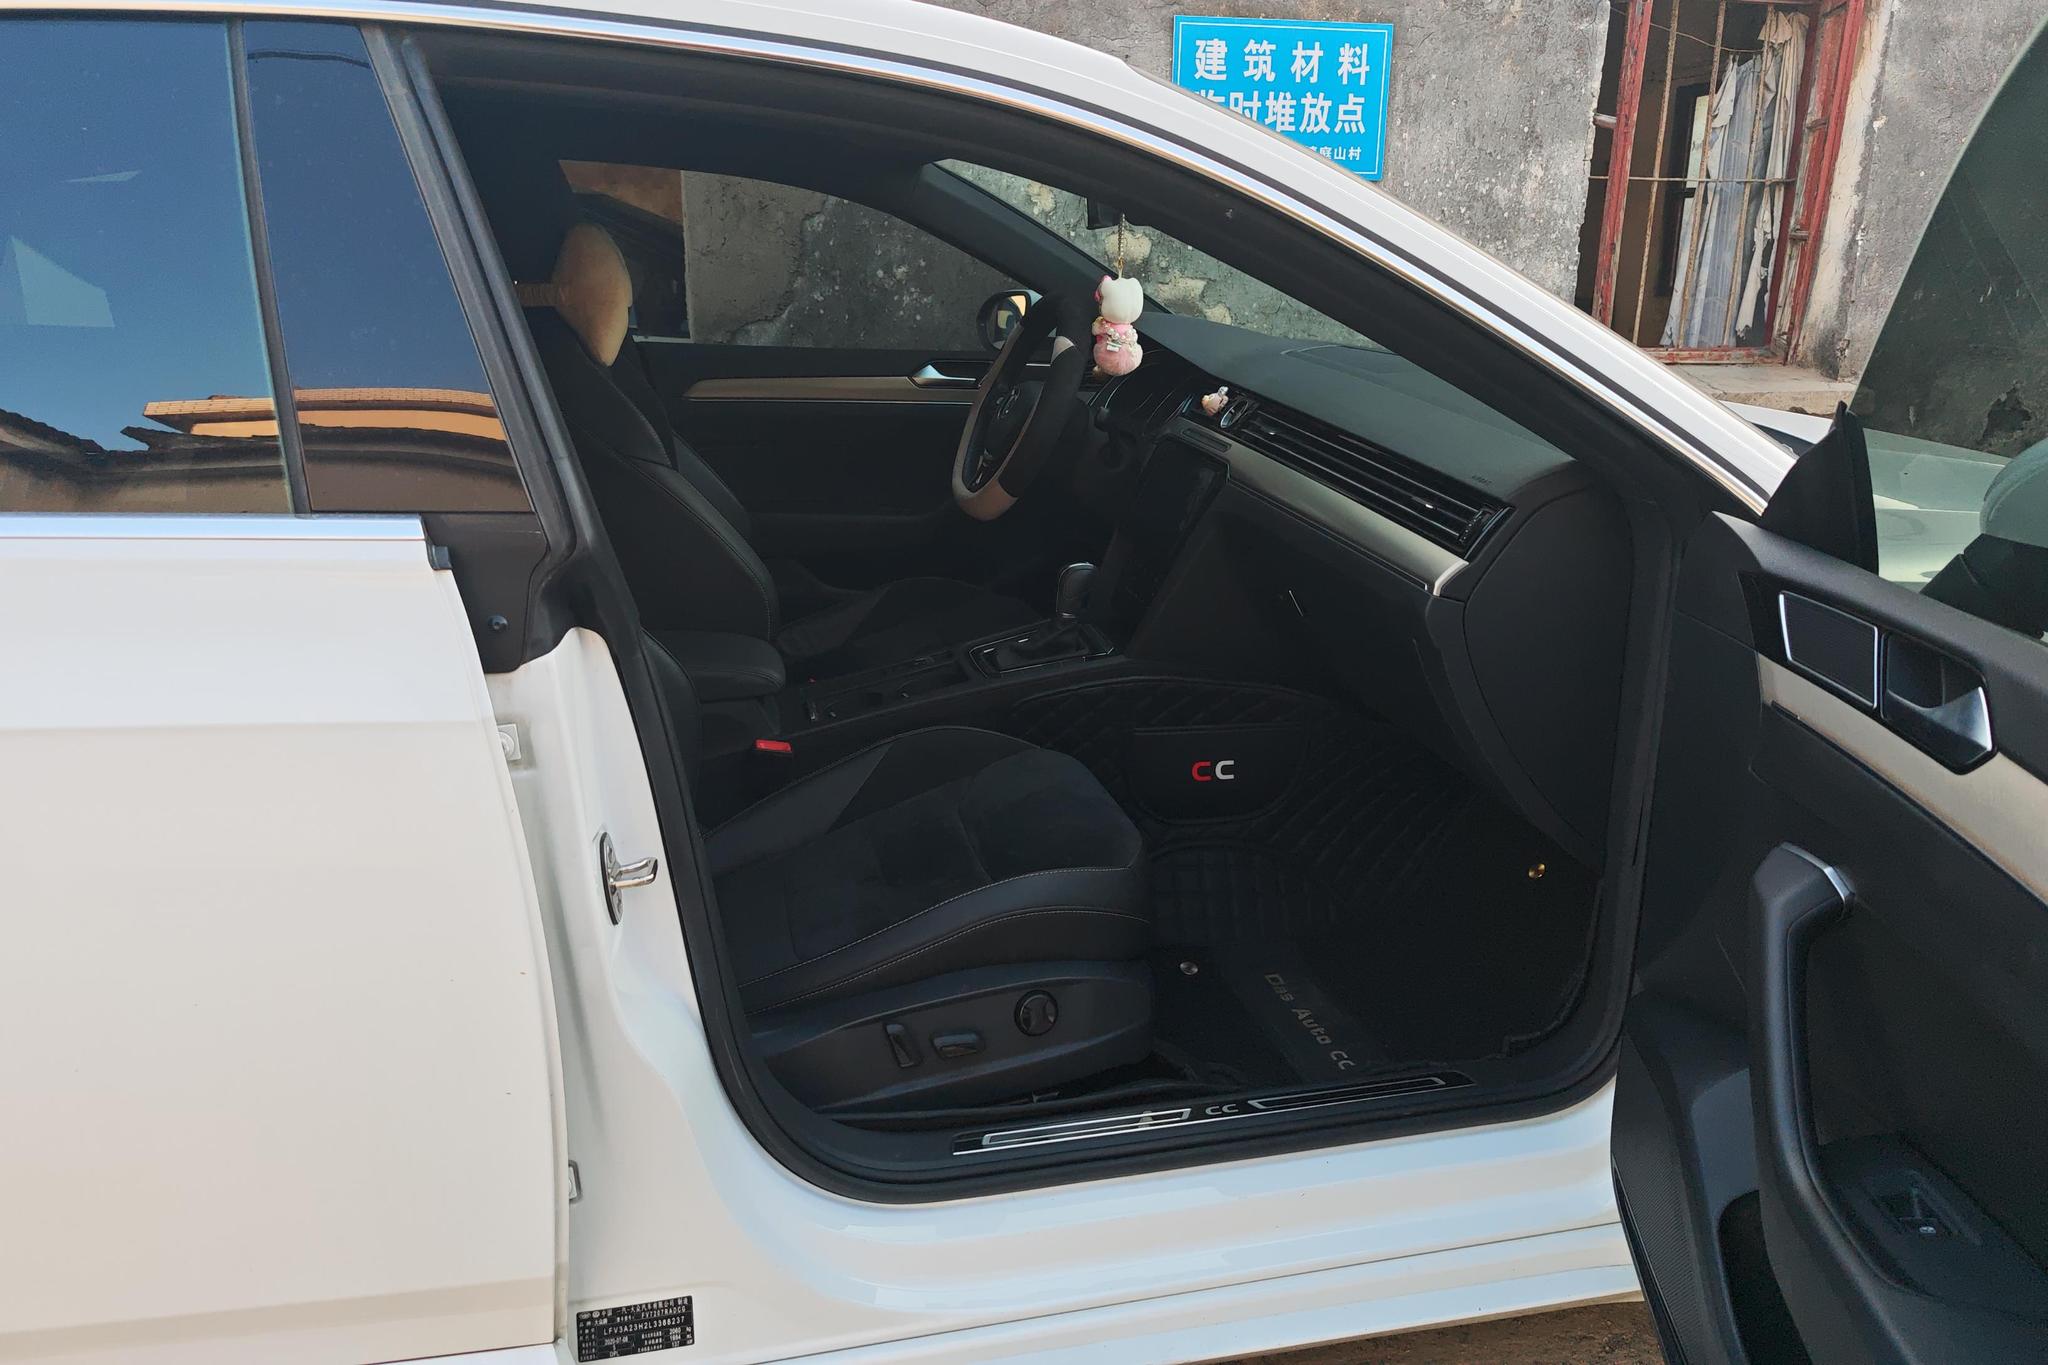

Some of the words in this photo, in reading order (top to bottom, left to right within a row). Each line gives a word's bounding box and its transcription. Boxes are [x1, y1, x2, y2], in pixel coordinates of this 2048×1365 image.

[1194, 38, 1370, 86] 建筑材料
[1191, 760, 1235, 782] CC
[1291, 1008, 1332, 1045] Auto
[1330, 1050, 1357, 1071] CC
[1205, 1103, 1240, 1116] CC
